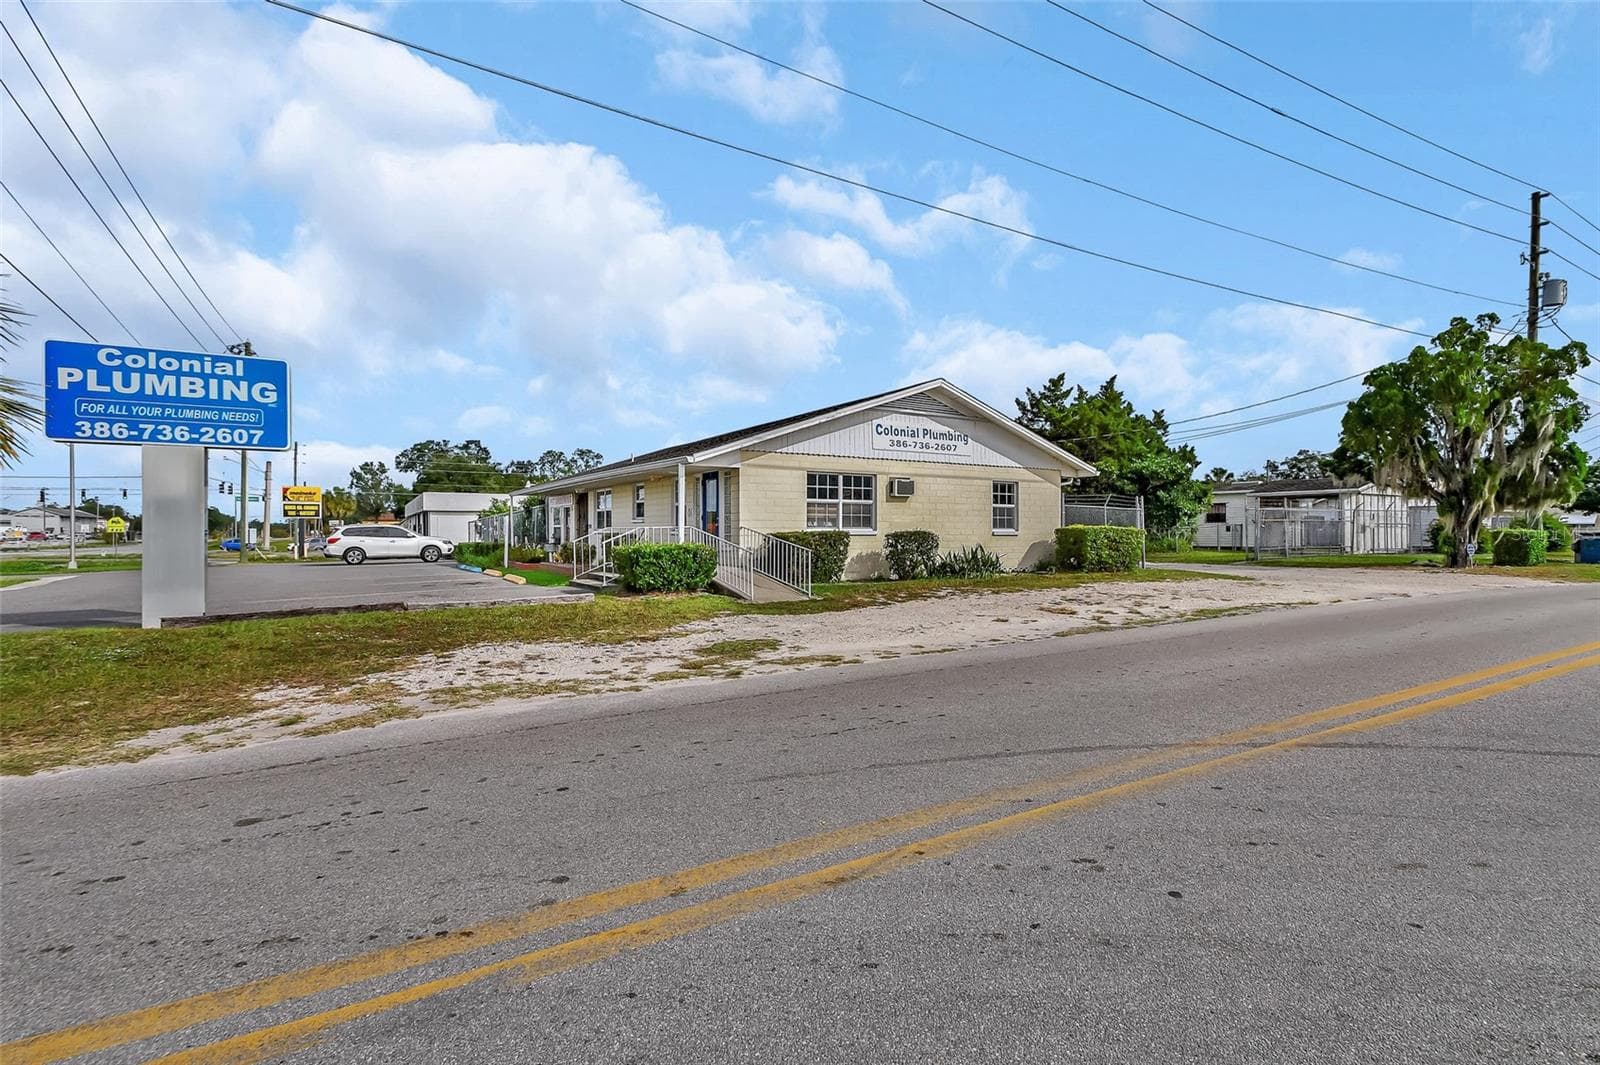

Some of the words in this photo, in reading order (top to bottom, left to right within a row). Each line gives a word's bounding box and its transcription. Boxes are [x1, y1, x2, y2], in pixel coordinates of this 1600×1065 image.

[96, 347, 244, 377] Colonial
[57, 366, 278, 404] PLUMBING
[80, 402, 105, 414] FOR
[108, 404, 129, 415] ALL
[131, 405, 162, 417] YOUR
[164, 407, 219, 420] PLUMBING
[221, 410, 259, 422] NEEDS!
[74, 420, 265, 445] 386-736-2607
[875, 423, 920, 439] Colonial
[922, 428, 969, 446] Plumbing
[889, 439, 957, 452] 386-736-2607
